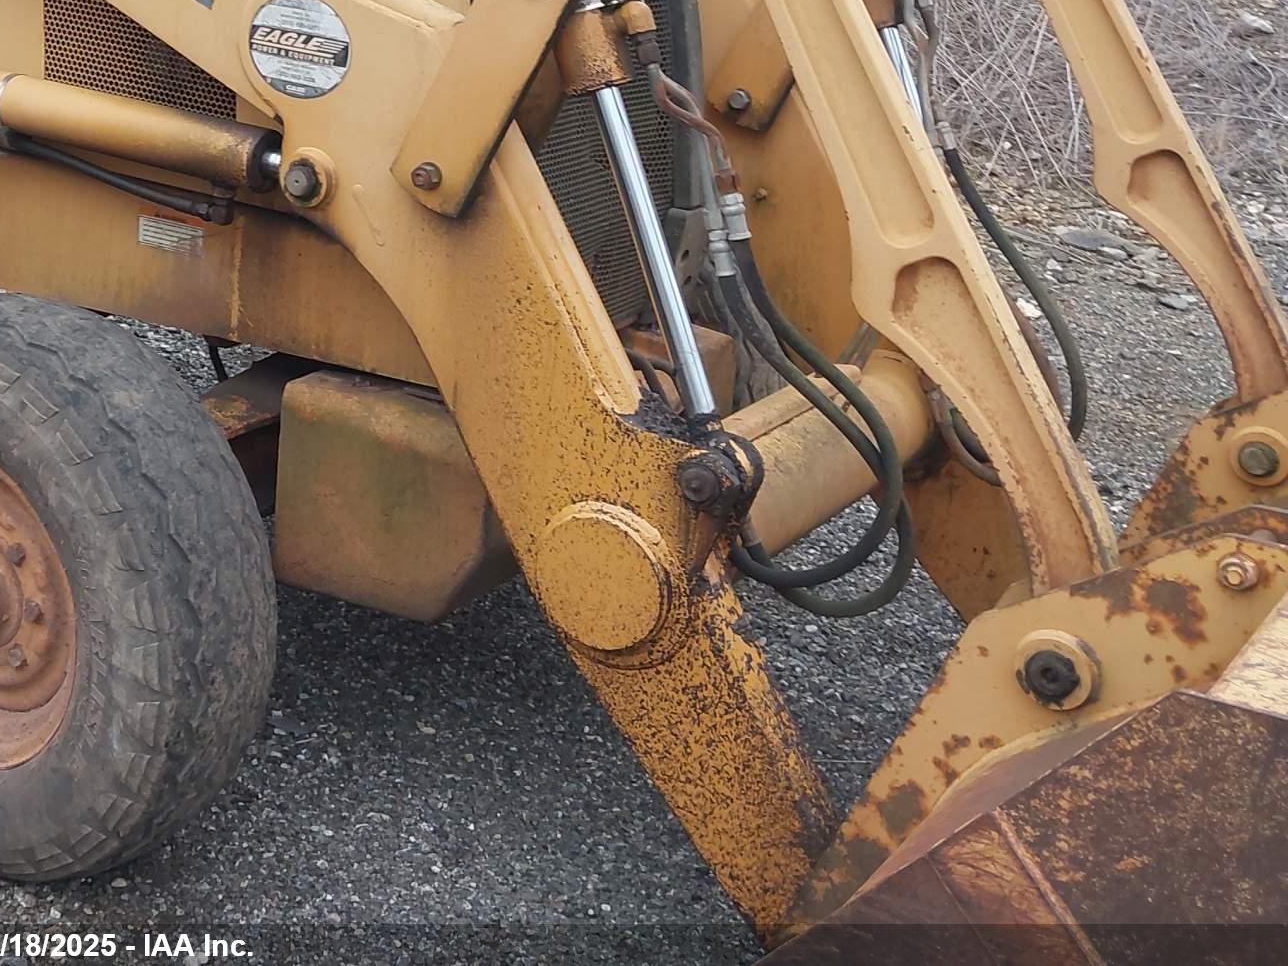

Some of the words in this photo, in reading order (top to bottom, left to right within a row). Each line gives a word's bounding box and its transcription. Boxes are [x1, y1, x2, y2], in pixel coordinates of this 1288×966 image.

[253, 27, 329, 51] EAGLE
[252, 44, 278, 55] POWER
[279, 48, 287, 57] &
[287, 51, 336, 66] EQUIPMENT
